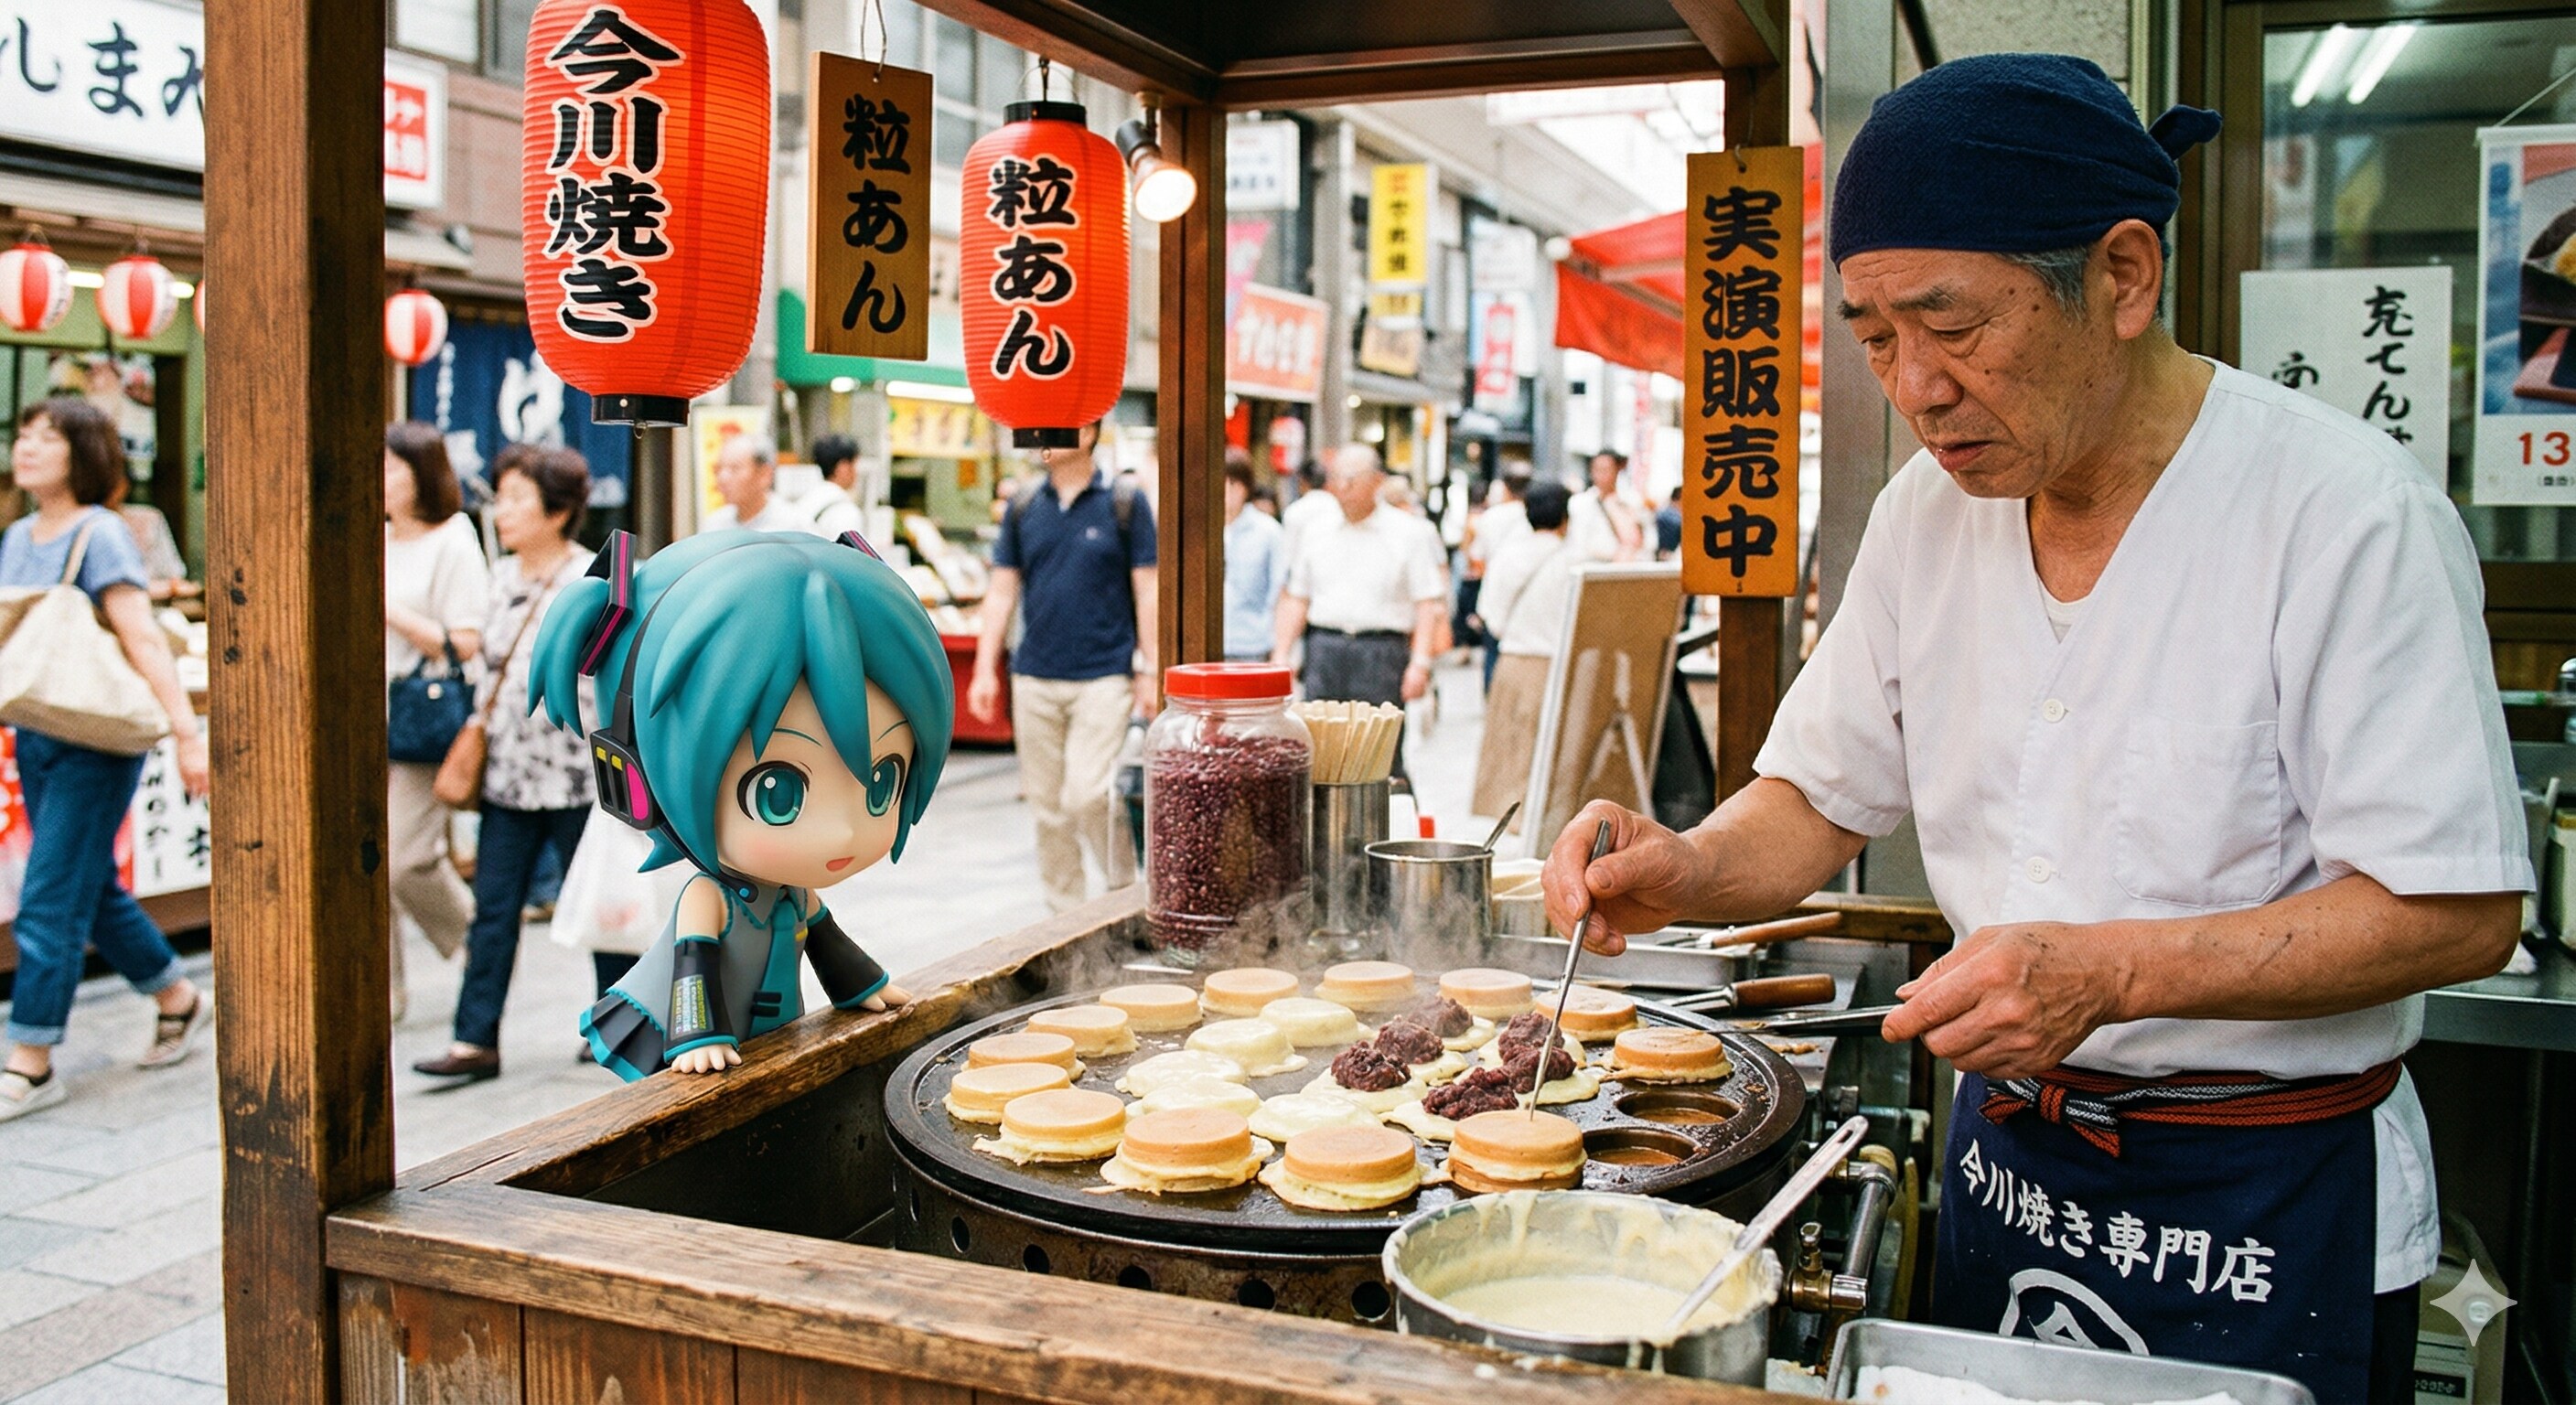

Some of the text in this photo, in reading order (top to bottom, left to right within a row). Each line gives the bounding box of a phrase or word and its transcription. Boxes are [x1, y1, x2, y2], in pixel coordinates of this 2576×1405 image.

[0, 17, 203, 126] しまみ
[547, 9, 681, 338] 今川焼き
[842, 92, 912, 334] 粒あん
[990, 157, 1076, 376] 粒あん
[1701, 186, 1783, 578] 実演販売中
[2520, 431, 2571, 467] 13
[1959, 1138, 2276, 1303] 今川焼き専門店
